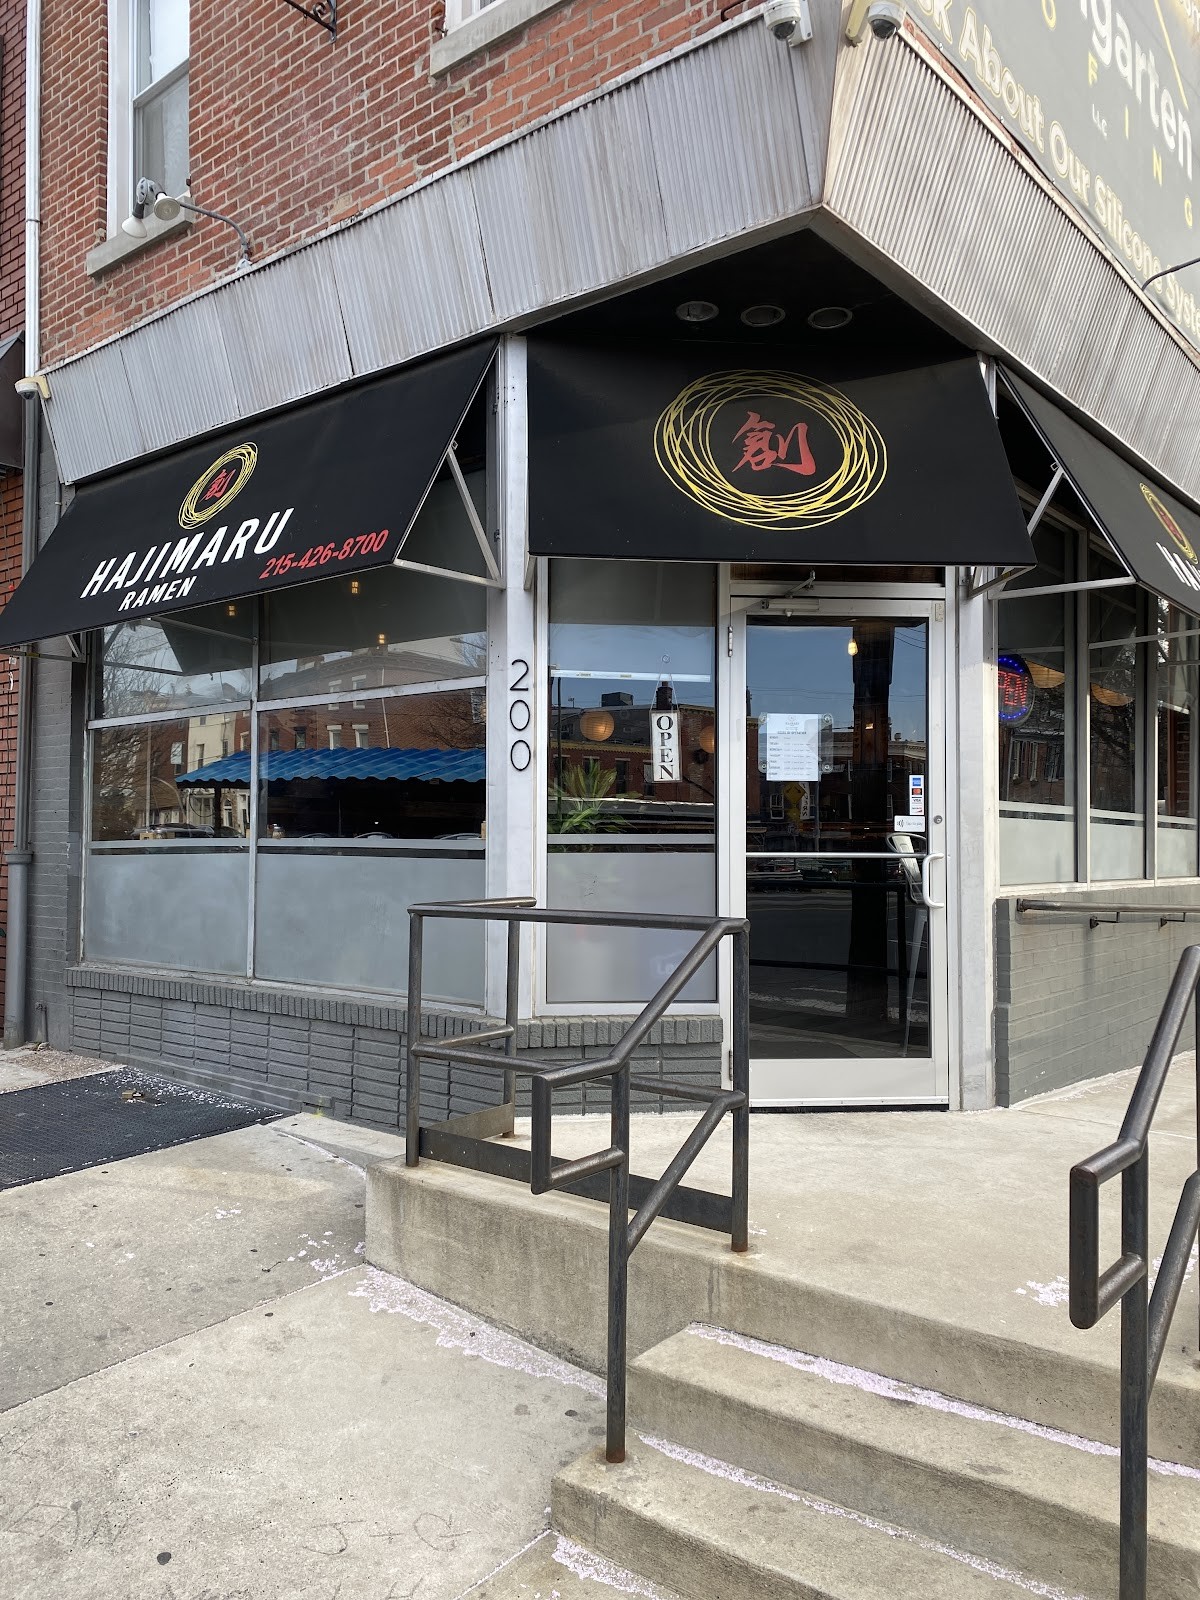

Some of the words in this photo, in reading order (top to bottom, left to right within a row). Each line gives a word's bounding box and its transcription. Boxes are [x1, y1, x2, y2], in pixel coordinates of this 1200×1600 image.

[1080, 0, 1192, 181] garten
[959, 6, 1043, 153] About
[1049, 120, 1090, 206] Our
[1095, 175, 1162, 294] Silicone
[80, 508, 293, 598] HAJIMARU
[118, 576, 196, 611] RAMEN
[259, 529, 389, 579] 215-426-8700
[509, 659, 531, 771] 200
[656, 715, 674, 780] OPEN
